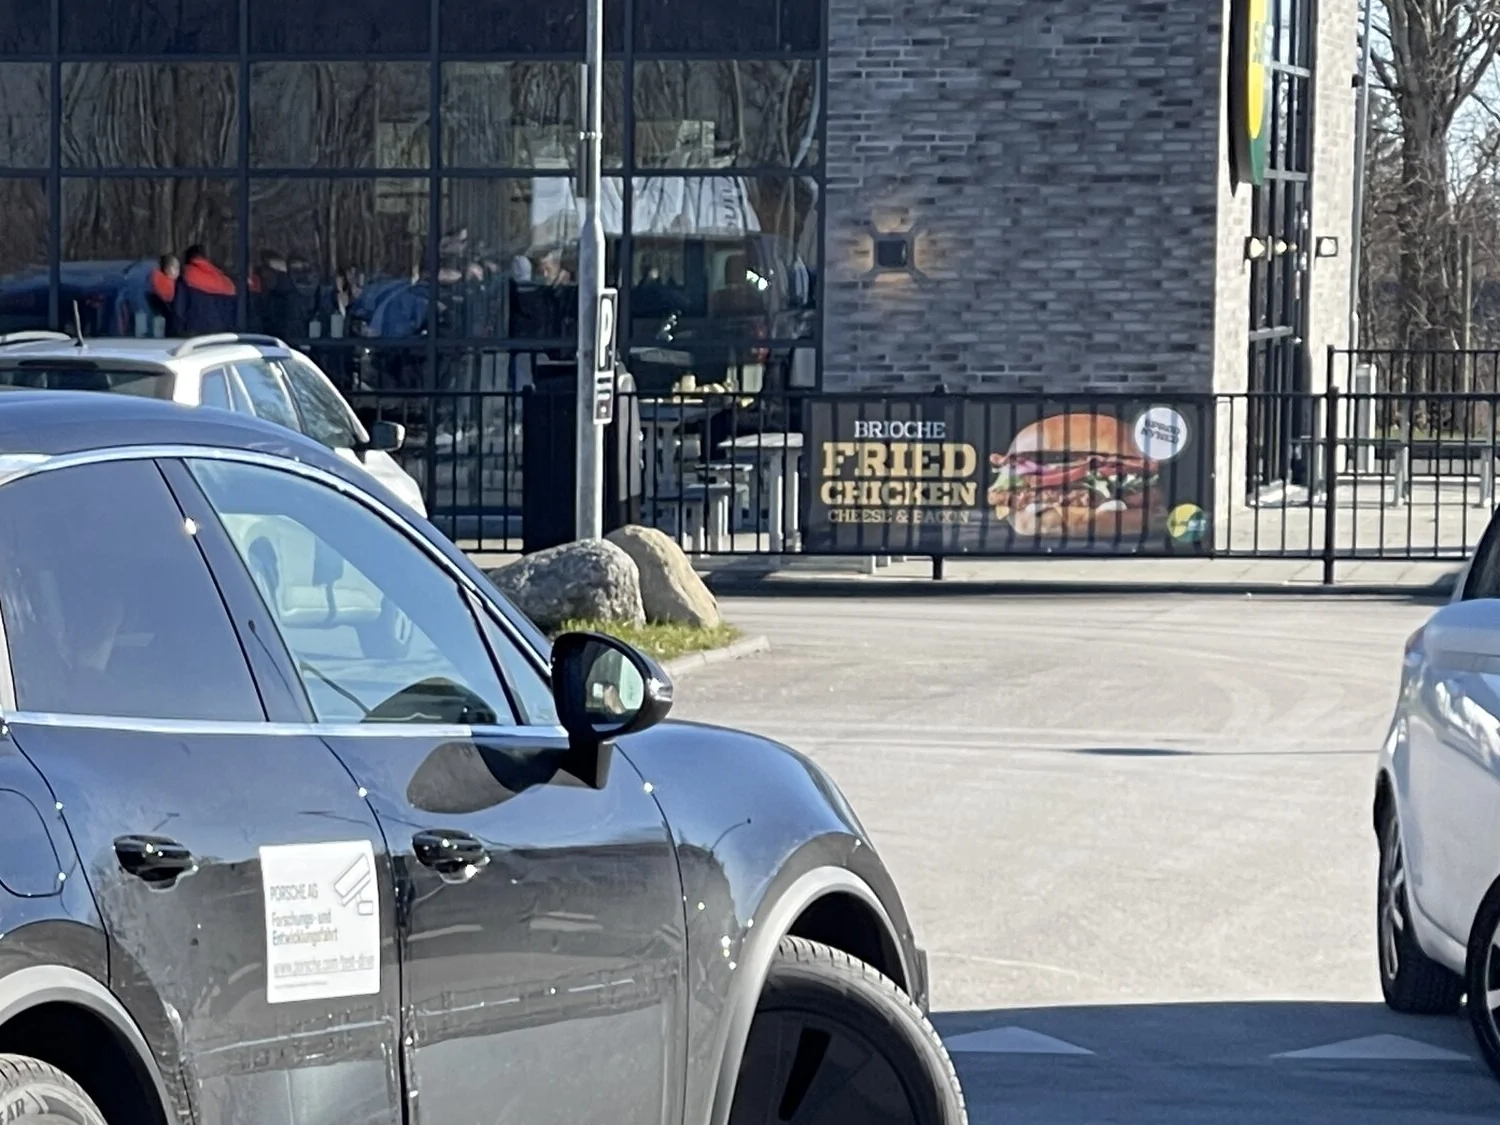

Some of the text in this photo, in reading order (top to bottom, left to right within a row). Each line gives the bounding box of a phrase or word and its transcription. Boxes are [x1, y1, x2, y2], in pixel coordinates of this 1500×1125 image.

[854, 420, 946, 439] BRIOCHE
[822, 442, 977, 477] FRIED
[820, 480, 977, 506] CHICKEN
[828, 510, 892, 523] CHEESE
[895, 511, 908, 523] &
